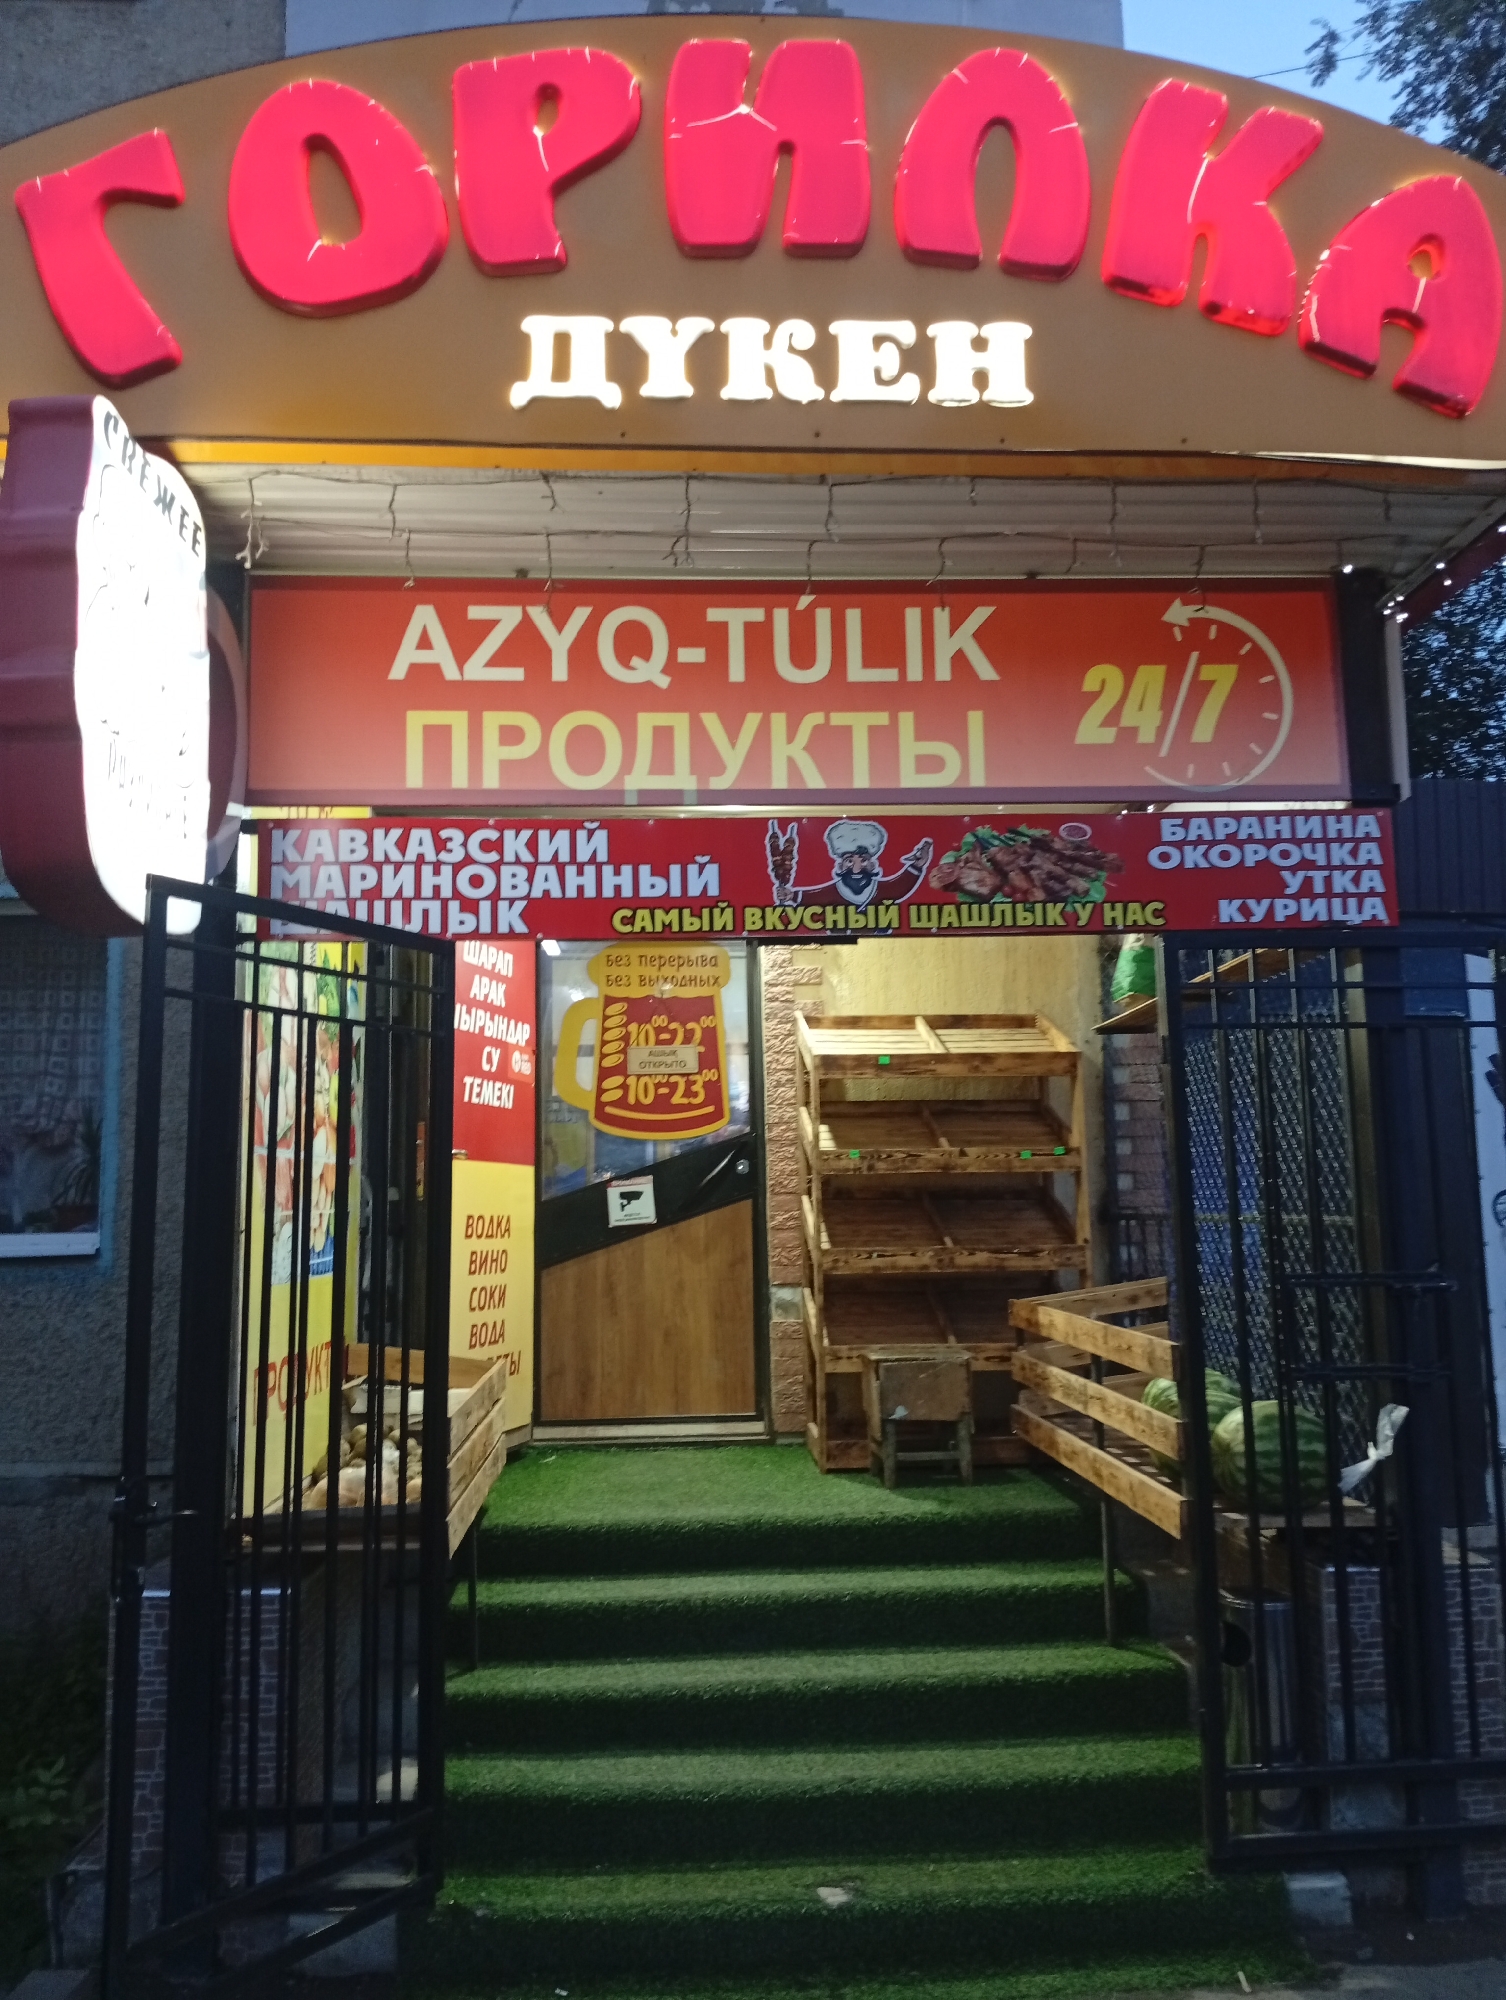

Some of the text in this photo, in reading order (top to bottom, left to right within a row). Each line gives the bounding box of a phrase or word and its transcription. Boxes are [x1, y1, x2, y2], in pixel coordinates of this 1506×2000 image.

[14, 36, 1503, 418] ГОРИЛКА
[388, 595, 1000, 689] AZYQ-TÚLIK
[1074, 651, 1239, 758] 24/7
[404, 710, 986, 806] ПРОДУКТЫ
[271, 821, 609, 864] КАВКАЗСКИЙ
[1160, 814, 1381, 842] БАРАНИНА
[1147, 842, 1384, 870] ОКОРОЧКА
[270, 856, 720, 900] МАРИНОВАННЫЙ
[1279, 869, 1386, 895] УТКА
[612, 900, 1166, 933] САМЫЙ ВКУСНЫЙ ШАШЛЫК У НАС
[1217, 897, 1388, 926] КУРИЦА
[463, 940, 513, 978] ШАРАП
[481, 1046, 500, 1072] СУ
[465, 1214, 511, 1240] ВОДКА
[468, 1249, 508, 1275] ВИНО
[469, 1284, 507, 1312] СОКИ
[468, 1319, 505, 1350] ВОДА
